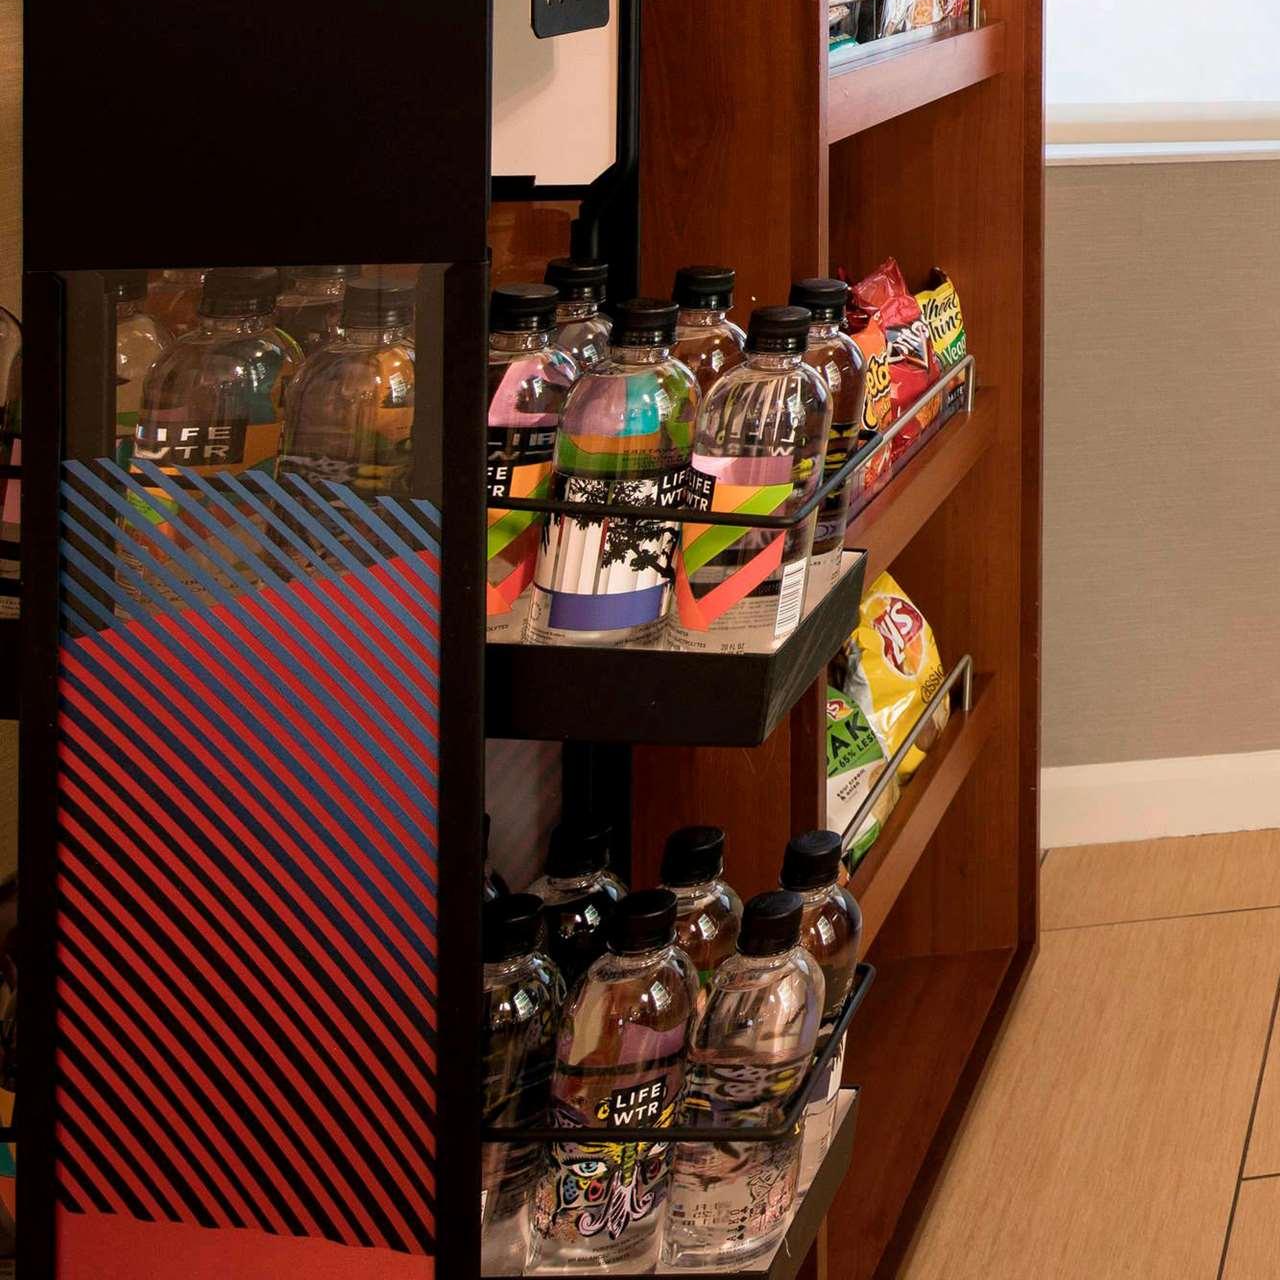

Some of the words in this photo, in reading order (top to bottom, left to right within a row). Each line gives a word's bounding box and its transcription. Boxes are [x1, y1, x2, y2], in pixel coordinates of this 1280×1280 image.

[662, 470, 686, 490] LIF
[661, 490, 682, 507] WT
[839, 751, 856, 770] 65%
[615, 1082, 663, 1110] LIFE
[612, 1101, 659, 1127] WTR
